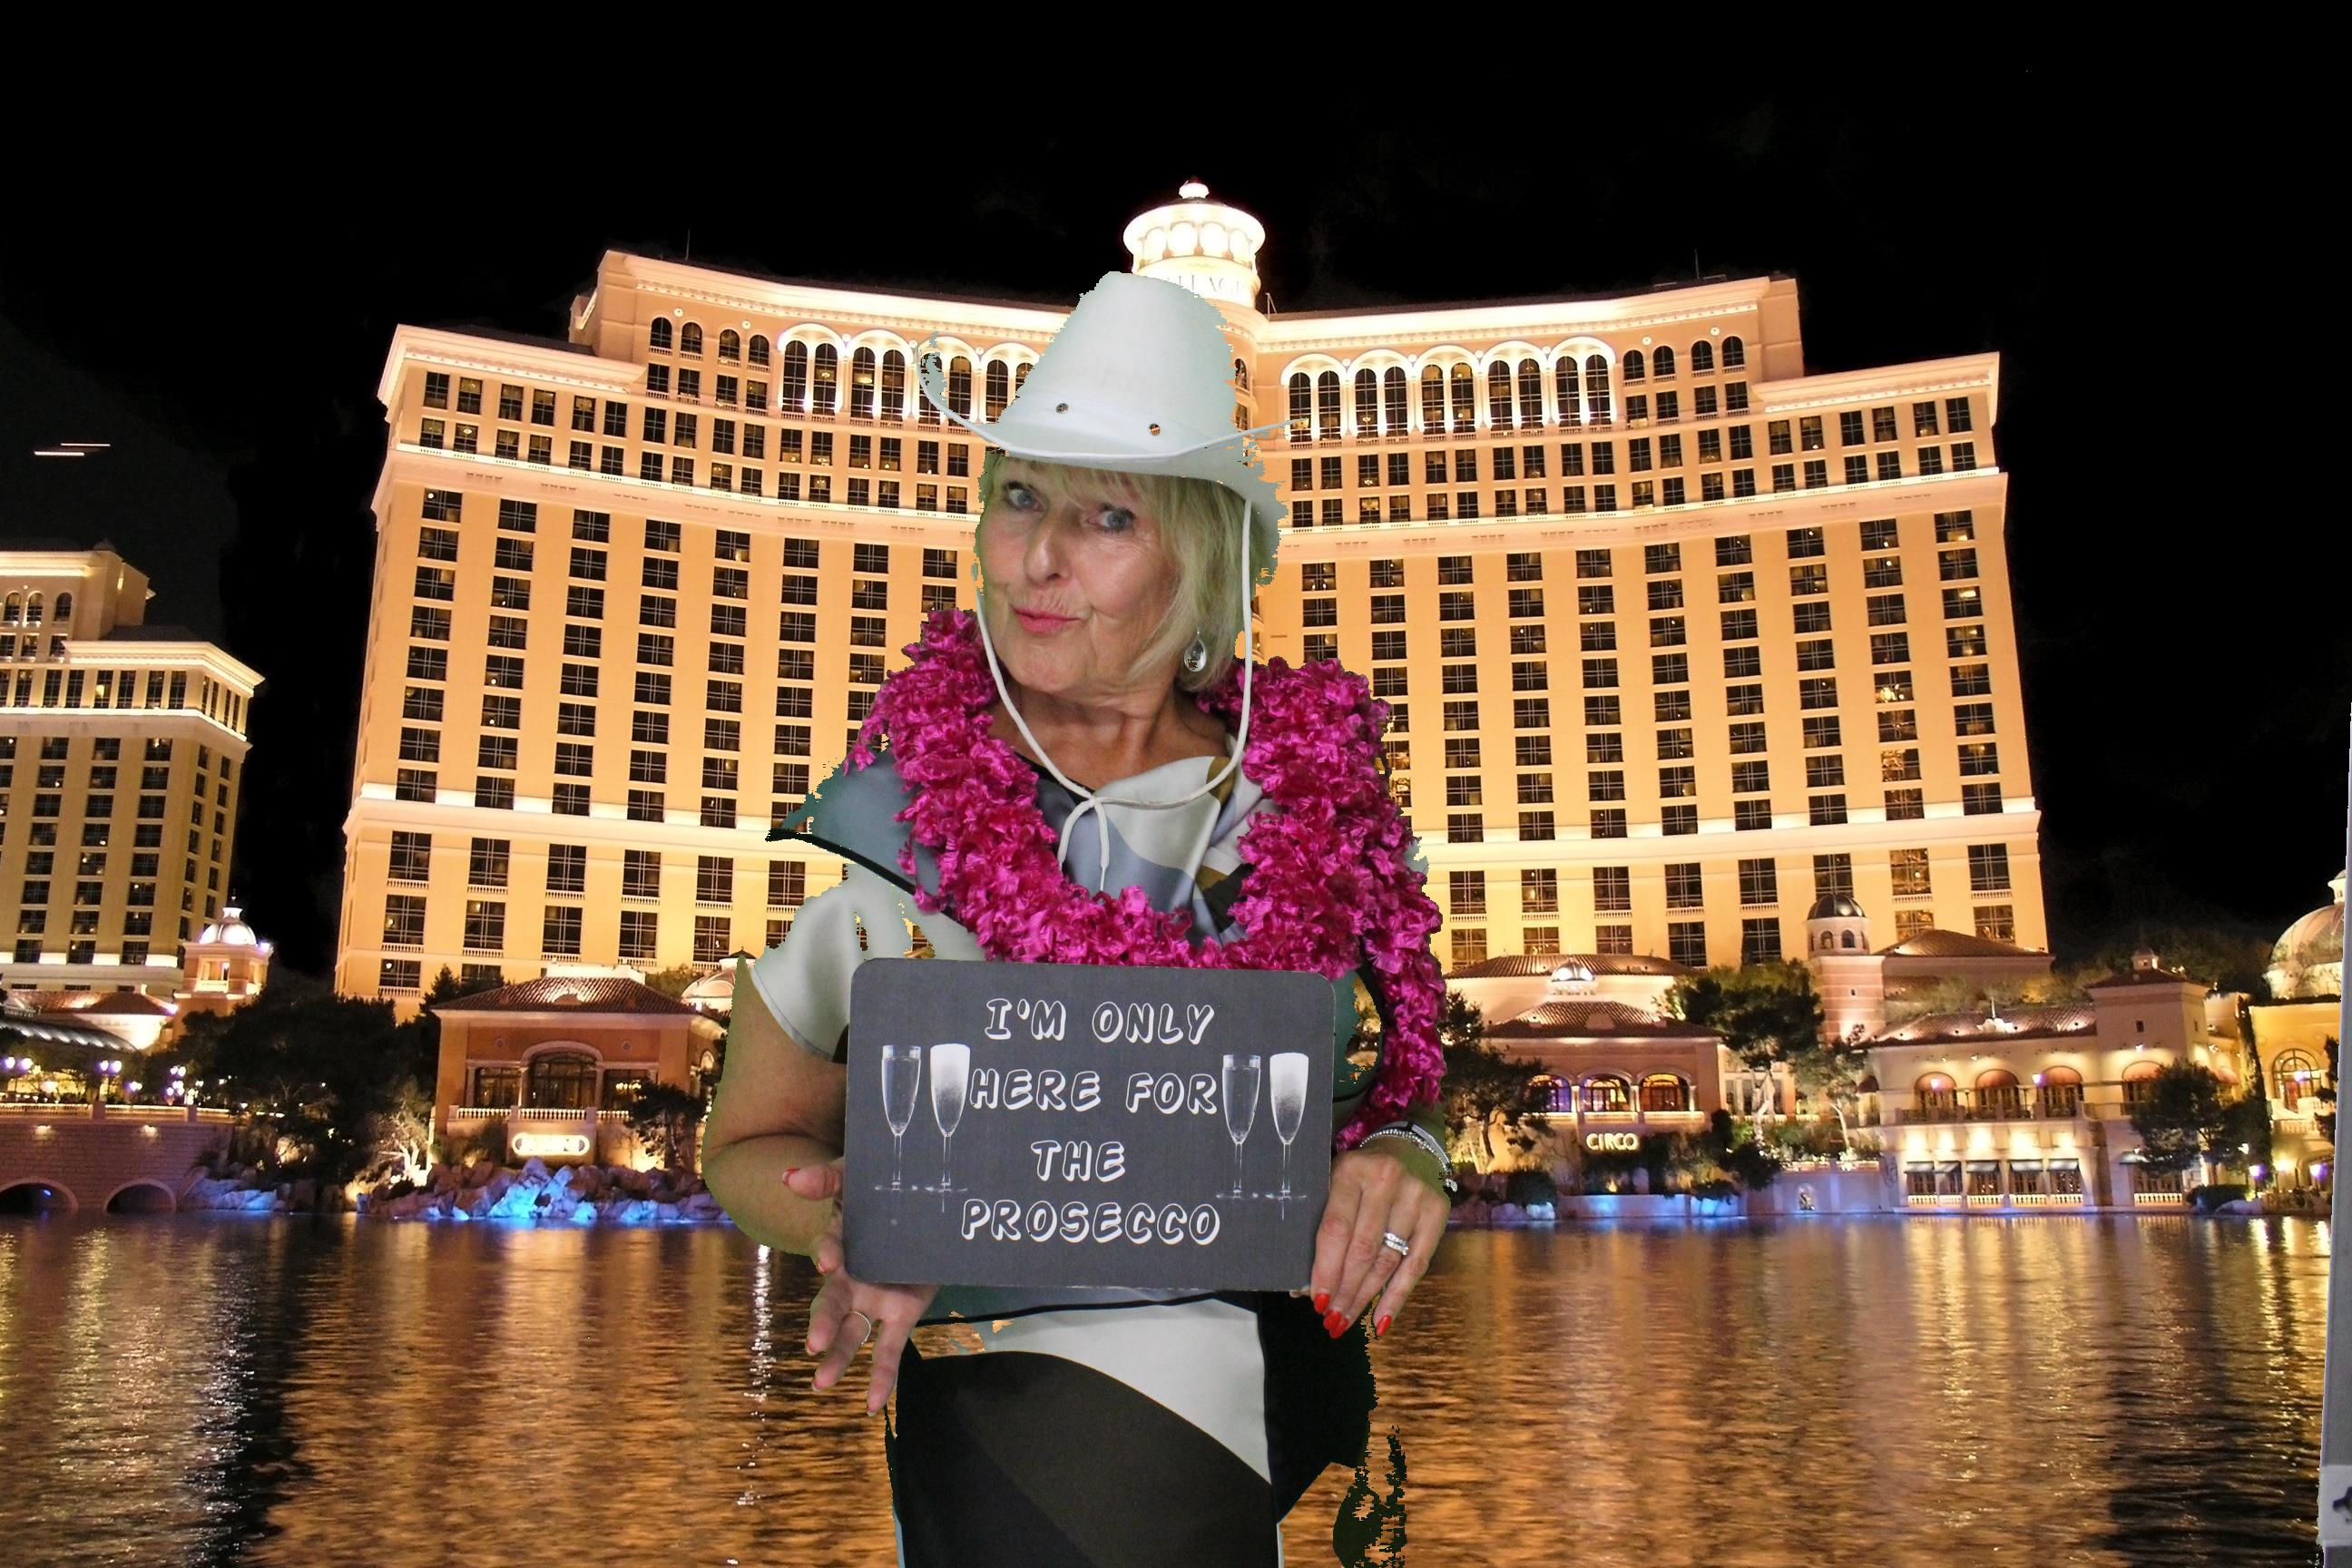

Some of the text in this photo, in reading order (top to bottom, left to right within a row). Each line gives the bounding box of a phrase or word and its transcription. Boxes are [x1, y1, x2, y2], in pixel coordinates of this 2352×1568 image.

[985, 998, 1215, 1044] I'M ONLY
[969, 1068, 1217, 1114] HERE FOR
[1031, 1140, 1125, 1182] THE
[1586, 1132, 1639, 1151] CIRCO
[961, 1198, 1220, 1246] PROSECCO
